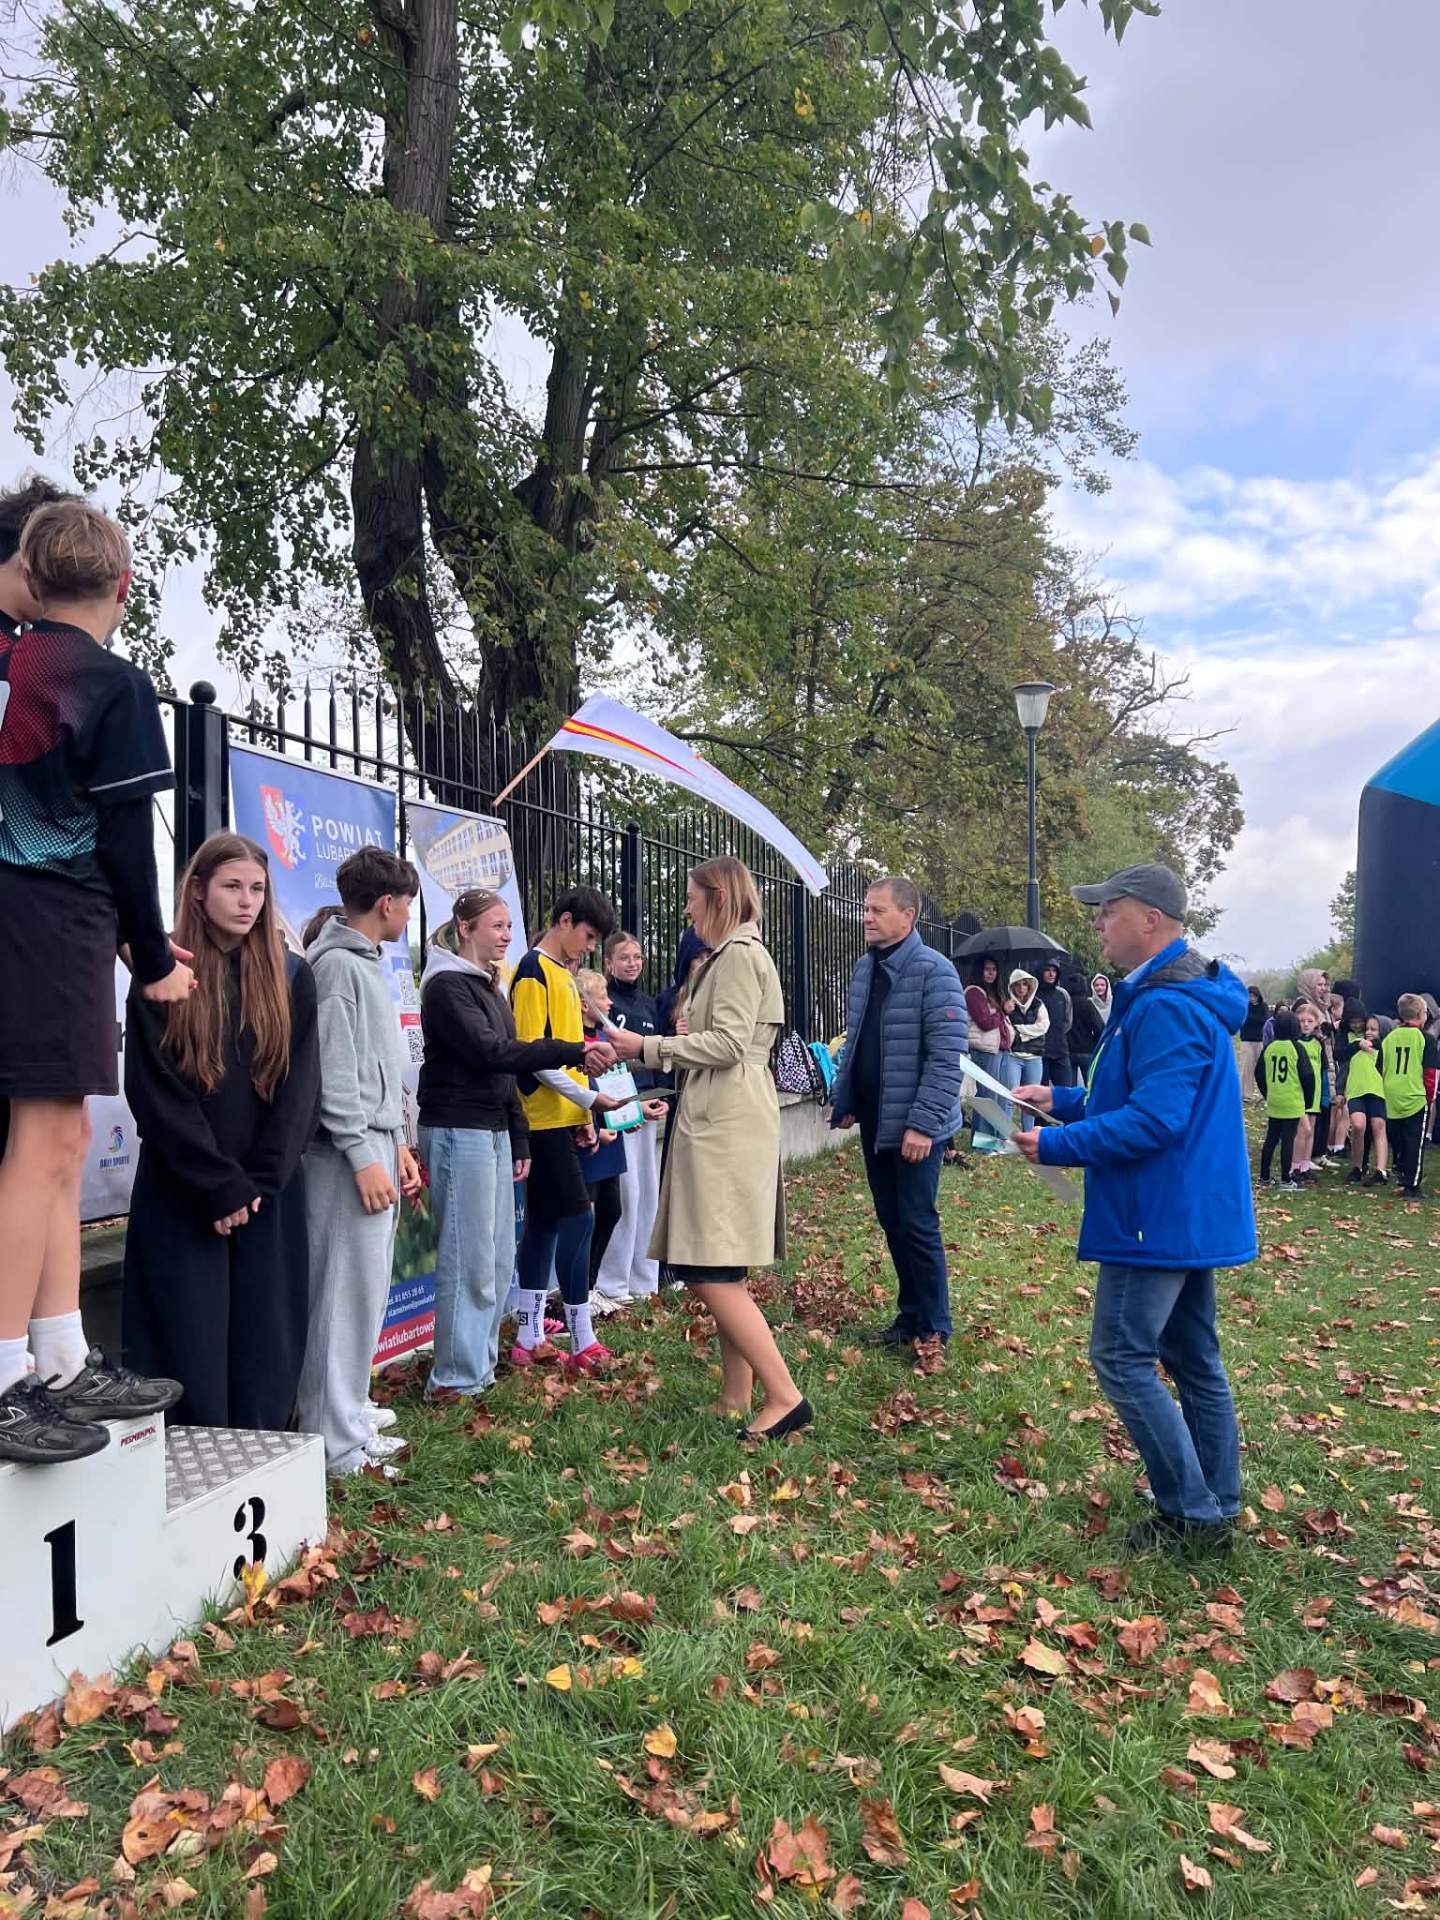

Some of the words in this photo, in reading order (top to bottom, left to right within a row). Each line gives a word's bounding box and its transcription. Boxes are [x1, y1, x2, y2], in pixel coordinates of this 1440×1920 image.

[311, 814, 382, 849] POWIAT
[315, 841, 355, 862] LUBAR
[1270, 1055, 1288, 1084] 19
[1394, 1046, 1411, 1075] 11
[233, 1496, 268, 1582] 3
[43, 1518, 85, 1648] 1
